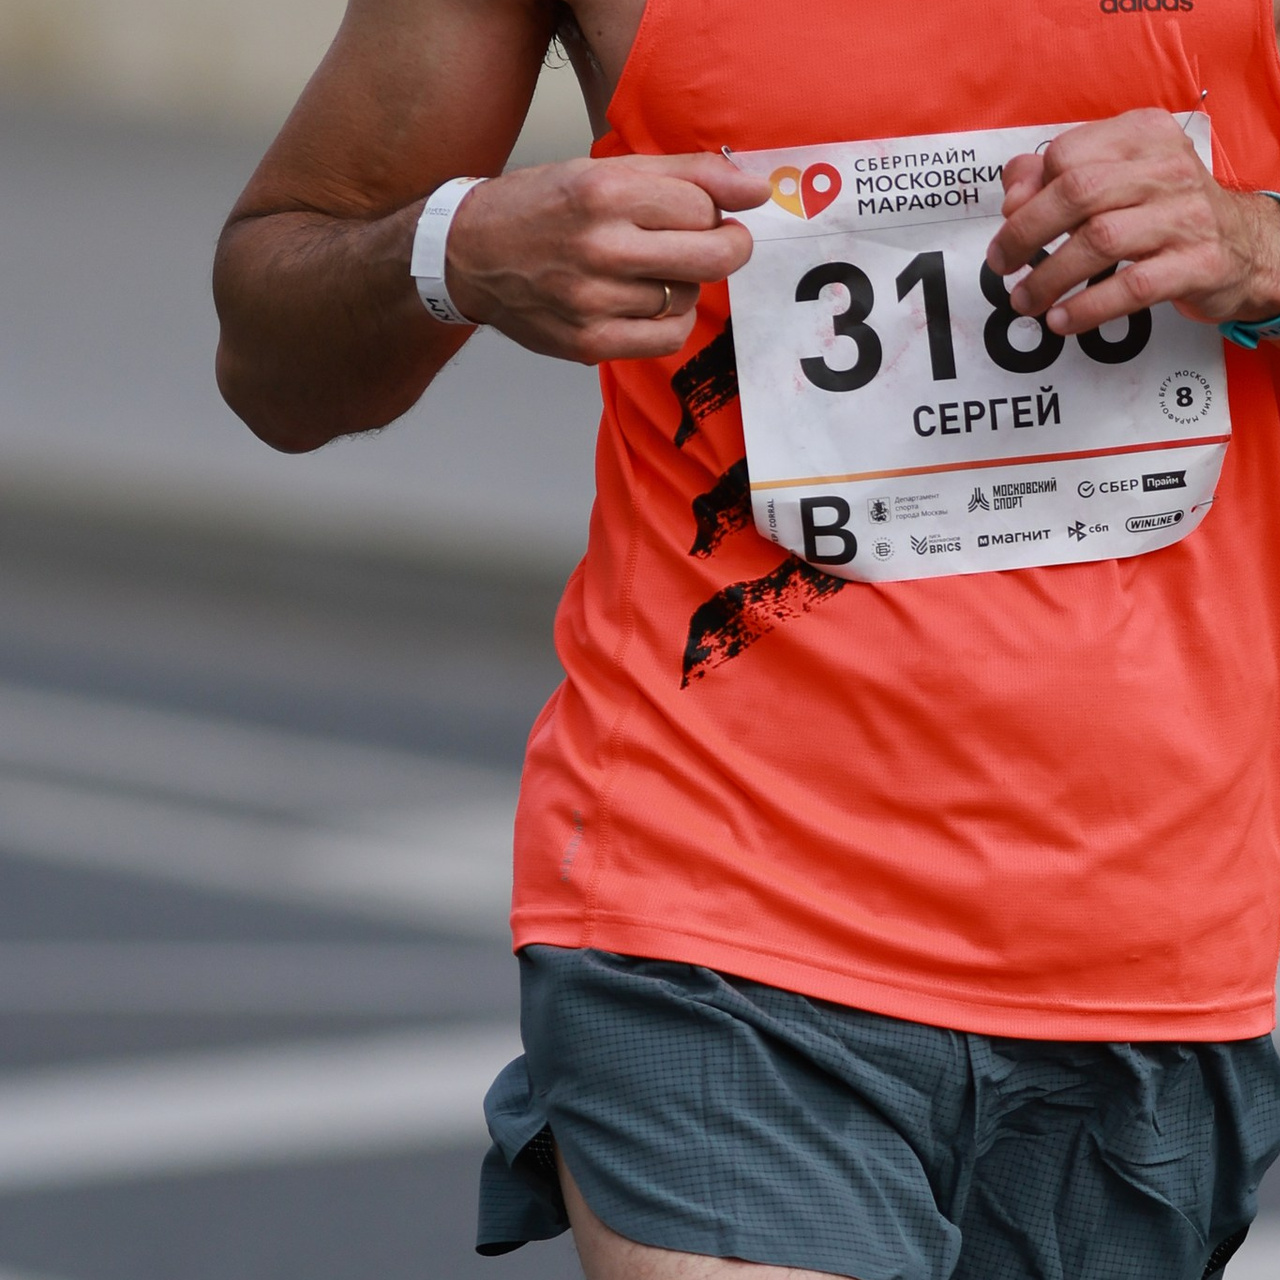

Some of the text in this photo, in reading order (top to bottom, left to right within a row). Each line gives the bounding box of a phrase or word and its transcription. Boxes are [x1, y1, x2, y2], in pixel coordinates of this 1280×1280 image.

[854, 147, 976, 173] СБЕРПРАЙМ
[856, 165, 1003, 195] МОСКОВСКИ
[858, 188, 979, 216] МАРАФОН
[1159, 370, 1213, 425] БЕГУ МОСКОВСКИЙ МАРАФОН
[1176, 386, 1194, 408] 8
[913, 385, 1061, 437] СЕРГЕЙ
[993, 477, 1057, 497] МОСКОВСКИЙ
[1099, 476, 1179, 493] СБЕР Прайм
[894, 493, 940, 504] Департамент
[994, 496, 1023, 510] СПОРТ
[767, 498, 777, 528] CORRAL
[895, 504, 919, 512] спорта
[896, 512, 920, 520] города
[800, 496, 857, 565] B
[1089, 524, 1109, 533] сбп
[1130, 515, 1173, 529] WINLINE
[991, 529, 1051, 545] магнит
[929, 542, 961, 554] BRICS
